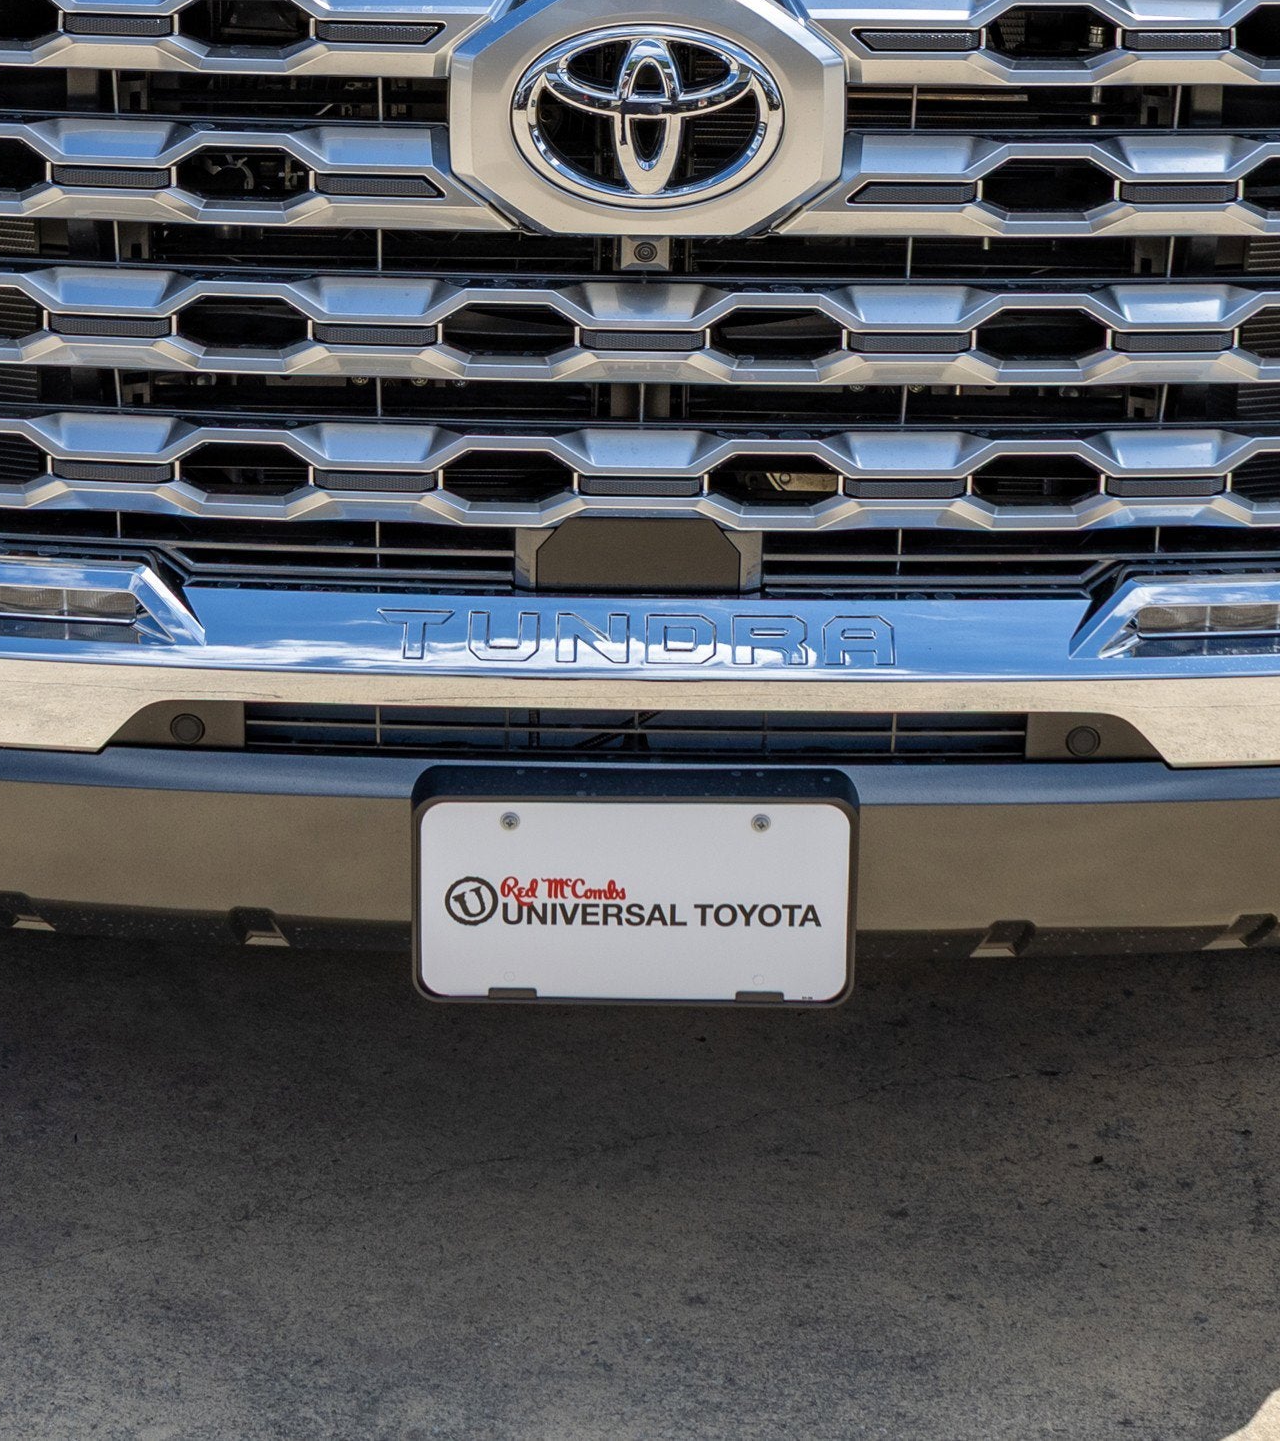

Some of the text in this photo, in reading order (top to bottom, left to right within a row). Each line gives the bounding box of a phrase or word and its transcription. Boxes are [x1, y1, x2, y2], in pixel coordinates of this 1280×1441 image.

[376, 607, 897, 666] TUNDRA
[500, 876, 626, 907] Red McCombs
[502, 902, 822, 928] UNIVERSAL TOYOTA
